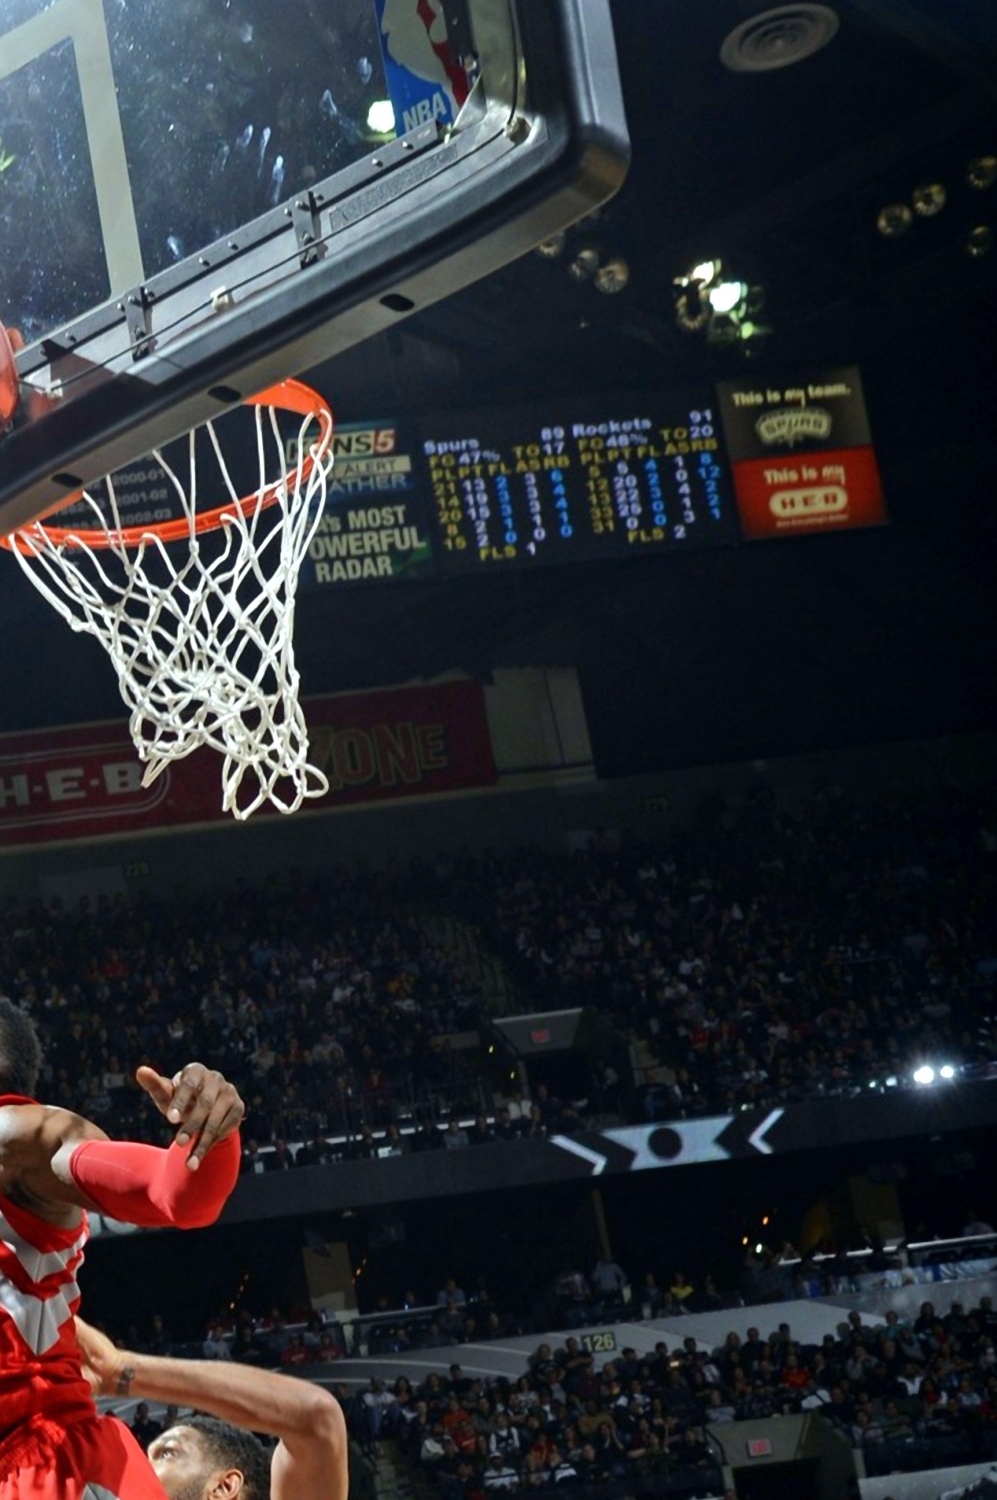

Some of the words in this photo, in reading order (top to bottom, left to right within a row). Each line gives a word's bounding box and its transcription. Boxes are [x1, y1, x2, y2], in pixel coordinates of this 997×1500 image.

[402, 91, 447, 132] NBA
[732, 391, 763, 407] This
[424, 439, 479, 455] Spurs
[572, 418, 651, 438] Rockets
[690, 408, 712, 423] 91
[660, 427, 687, 442] TO
[690, 424, 713, 439] 20
[513, 443, 540, 458] TO
[543, 441, 565, 455] 17
[763, 467, 798, 485] This
[347, 505, 406, 529] MOST
[308, 526, 426, 560] OWERFUL
[315, 556, 393, 583] RADAR
[583, 1333, 615, 1352] 126
